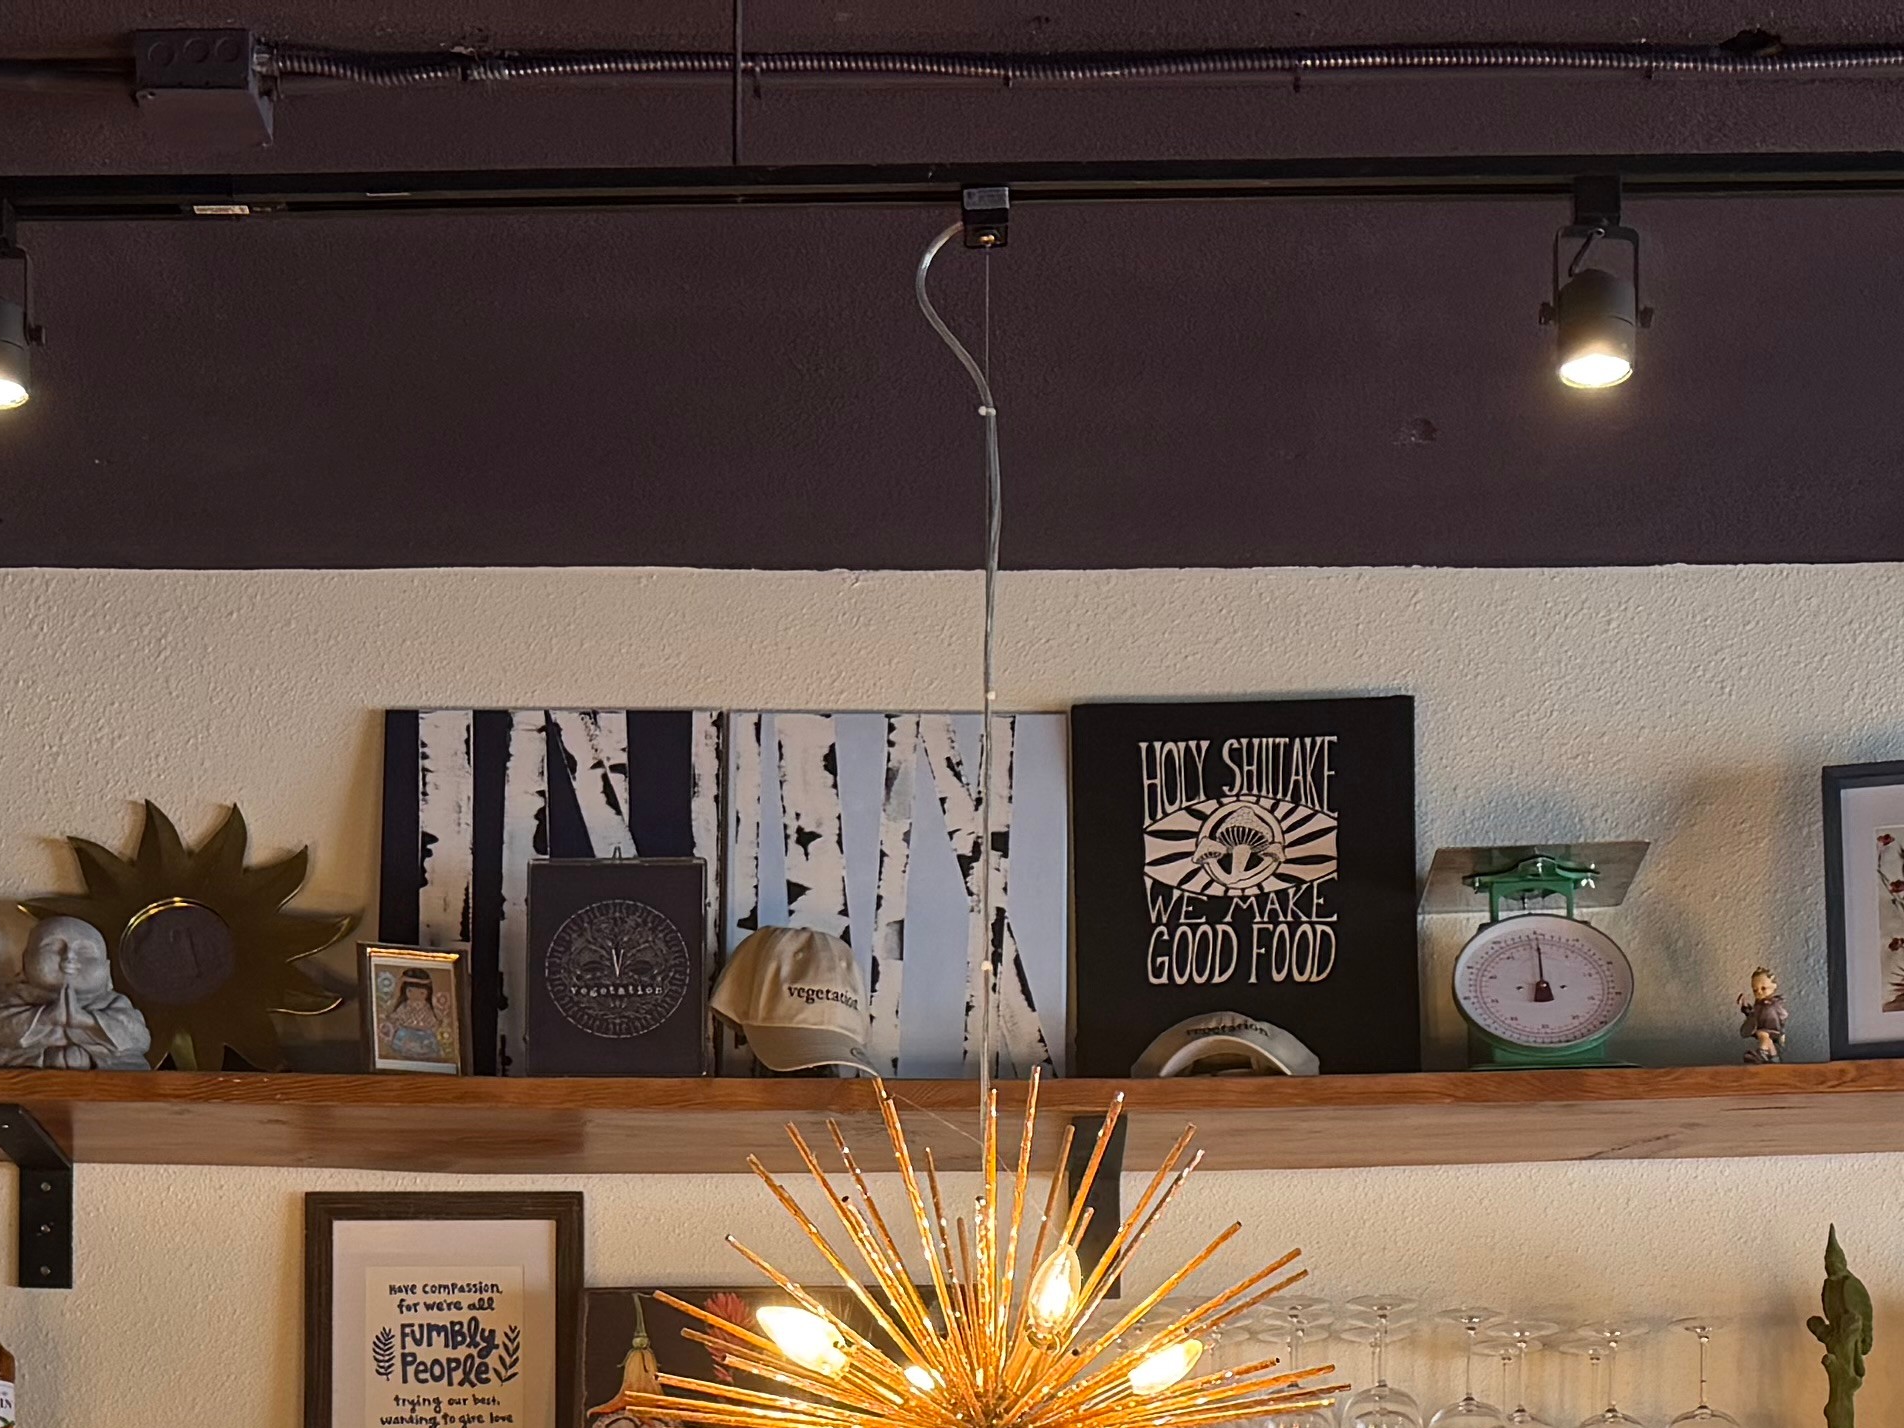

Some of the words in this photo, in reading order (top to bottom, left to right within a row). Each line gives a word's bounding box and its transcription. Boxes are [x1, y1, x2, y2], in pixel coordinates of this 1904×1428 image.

[1138, 740, 1211, 823] HOLY
[1144, 875, 1208, 925] WE
[1223, 872, 1339, 924] MAKE
[1147, 924, 1238, 986] GOOD
[1248, 923, 1337, 985] FOOD
[570, 984, 664, 998] vegetation
[396, 1298, 420, 1315] for
[422, 1299, 464, 1313] we're
[466, 1297, 495, 1312] all
[393, 1393, 443, 1414] trying
[447, 1396, 469, 1406] our
[442, 1412, 457, 1426] to
[489, 1412, 515, 1425] love
